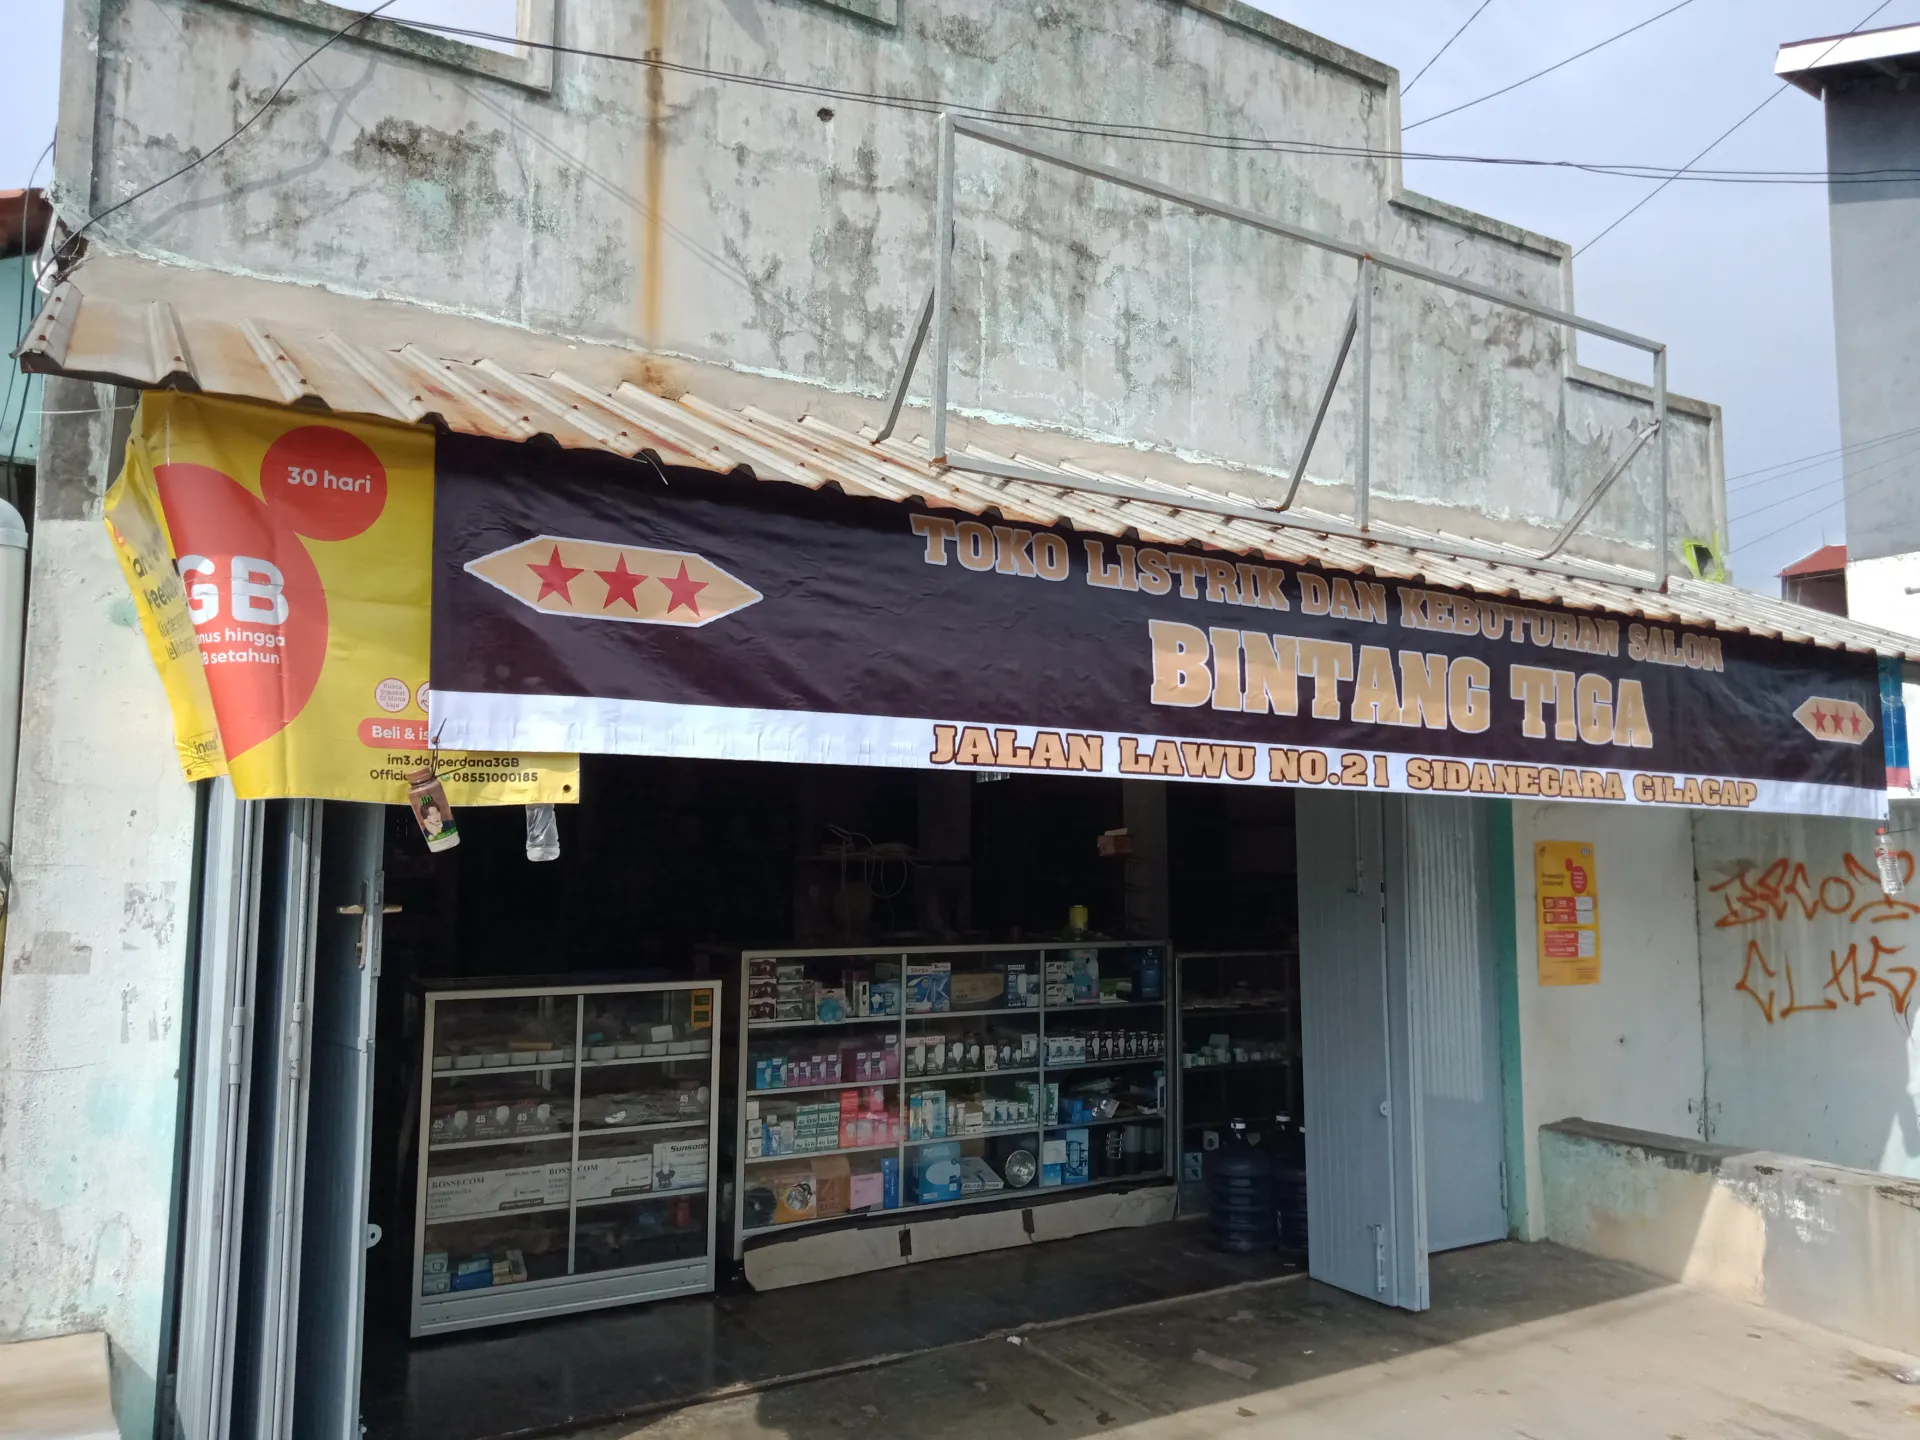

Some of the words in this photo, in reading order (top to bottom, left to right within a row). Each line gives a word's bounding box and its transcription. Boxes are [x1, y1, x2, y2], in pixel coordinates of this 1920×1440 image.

[287, 466, 317, 487] 30
[323, 474, 372, 494] hari
[178, 554, 289, 625] GB
[909, 513, 1069, 581] TOKO
[1084, 539, 1290, 612] LISTRIK
[1297, 572, 1387, 625] DAN
[1397, 586, 1619, 657] KEBUTUHAN
[1628, 623, 1724, 673] SALON
[197, 630, 221, 645] nus
[225, 627, 286, 647] hingga
[211, 648, 280, 665] setahun
[1148, 619, 1491, 733] BINTANG
[1510, 664, 1654, 748] TIGA
[372, 725, 401, 739] Beli
[404, 727, 416, 740] &
[453, 772, 538, 783] 08551000185
[930, 725, 1104, 772] JALAN
[1118, 737, 1257, 781] LAWU
[1269, 748, 1390, 788] NO.21
[1405, 758, 1626, 800] SIDANEGARA
[1633, 774, 1758, 808] CILACAP
